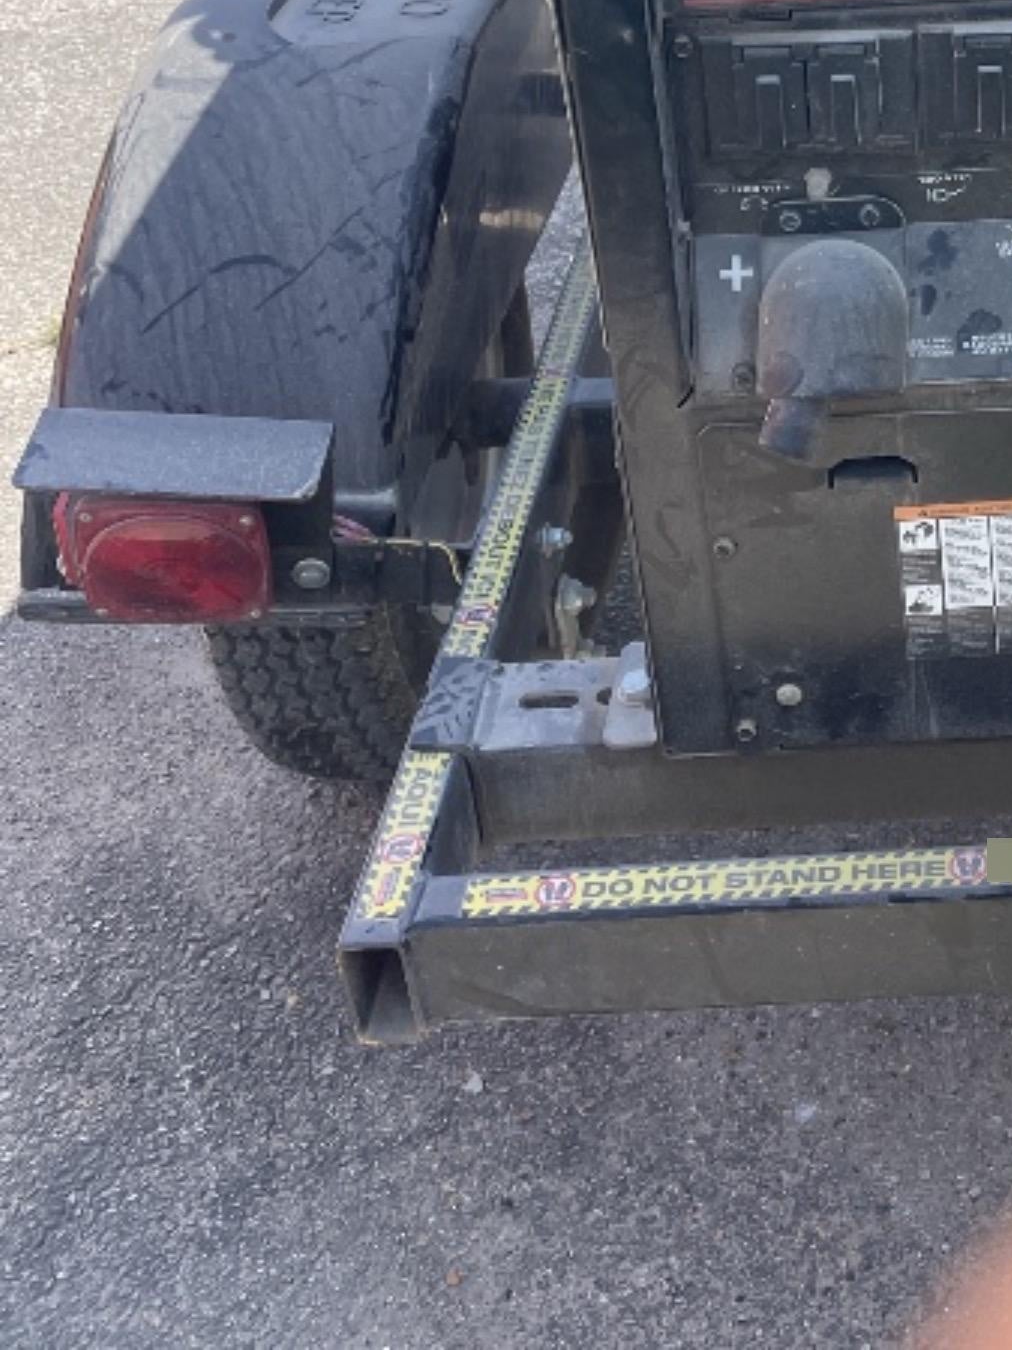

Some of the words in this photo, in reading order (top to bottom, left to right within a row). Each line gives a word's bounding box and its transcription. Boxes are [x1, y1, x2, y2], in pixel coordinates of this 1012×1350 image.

[581, 879, 634, 898] DO
[642, 873, 718, 894] NOT
[724, 866, 842, 890] STAND
[850, 859, 948, 881] HERE
